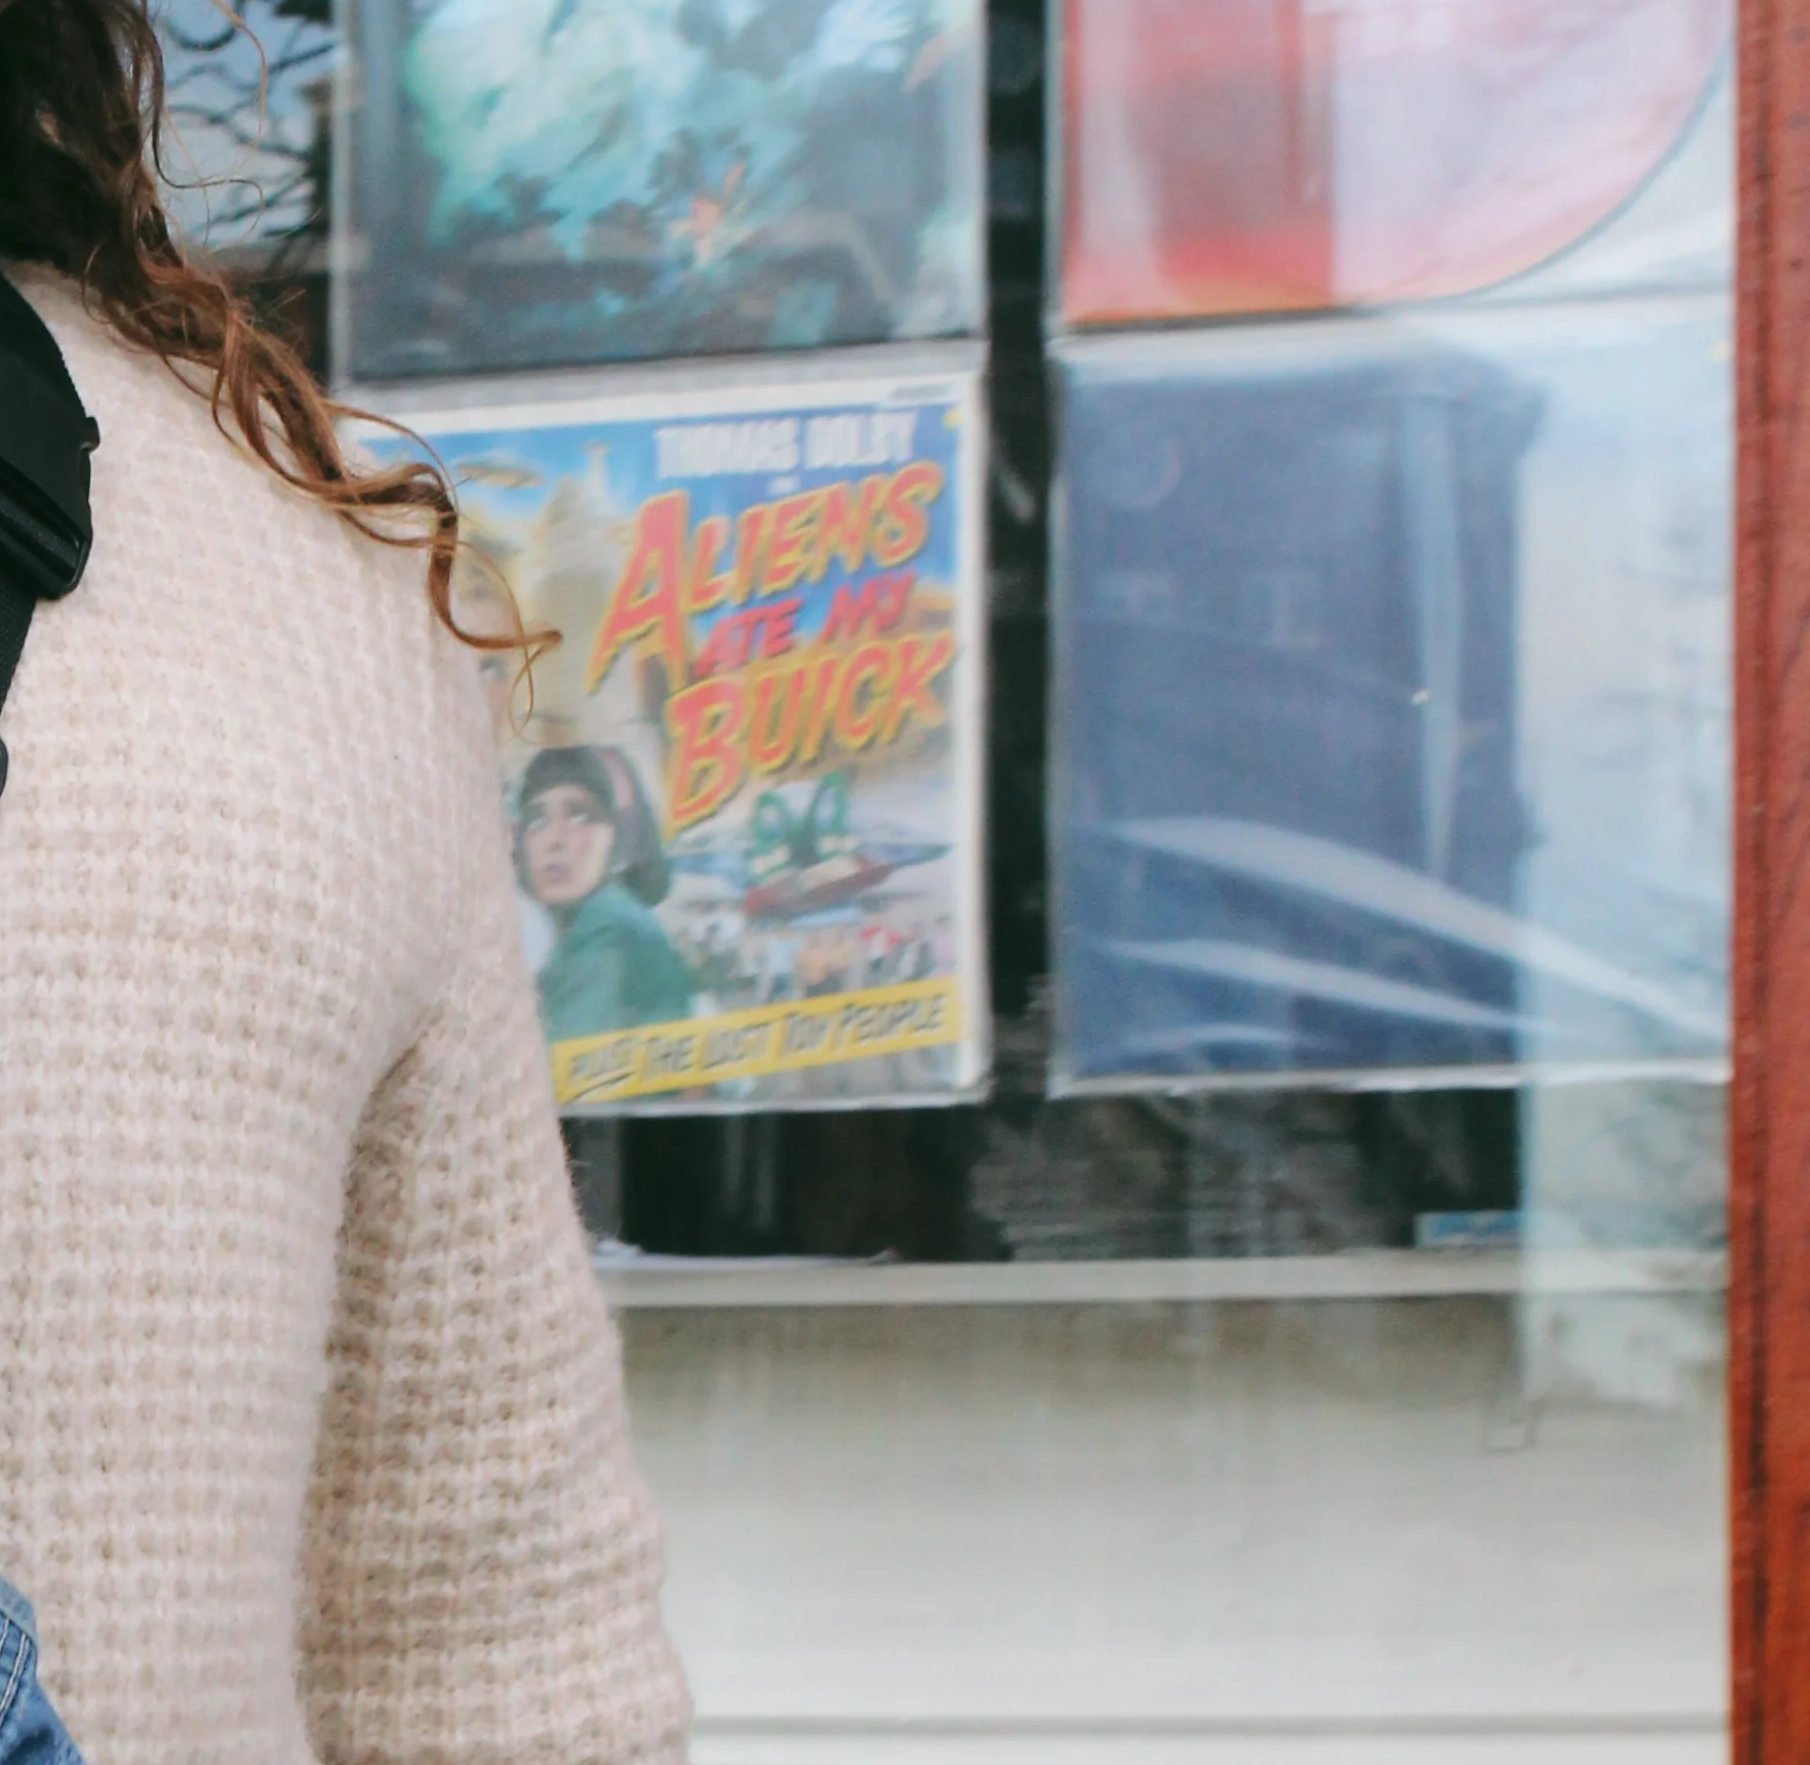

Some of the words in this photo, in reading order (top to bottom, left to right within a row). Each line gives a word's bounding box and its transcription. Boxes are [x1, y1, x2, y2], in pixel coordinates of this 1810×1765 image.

[585, 459, 943, 698] ALIENS
[694, 595, 804, 676] ATE
[818, 567, 917, 646] MY
[663, 629, 955, 844] BUICK
